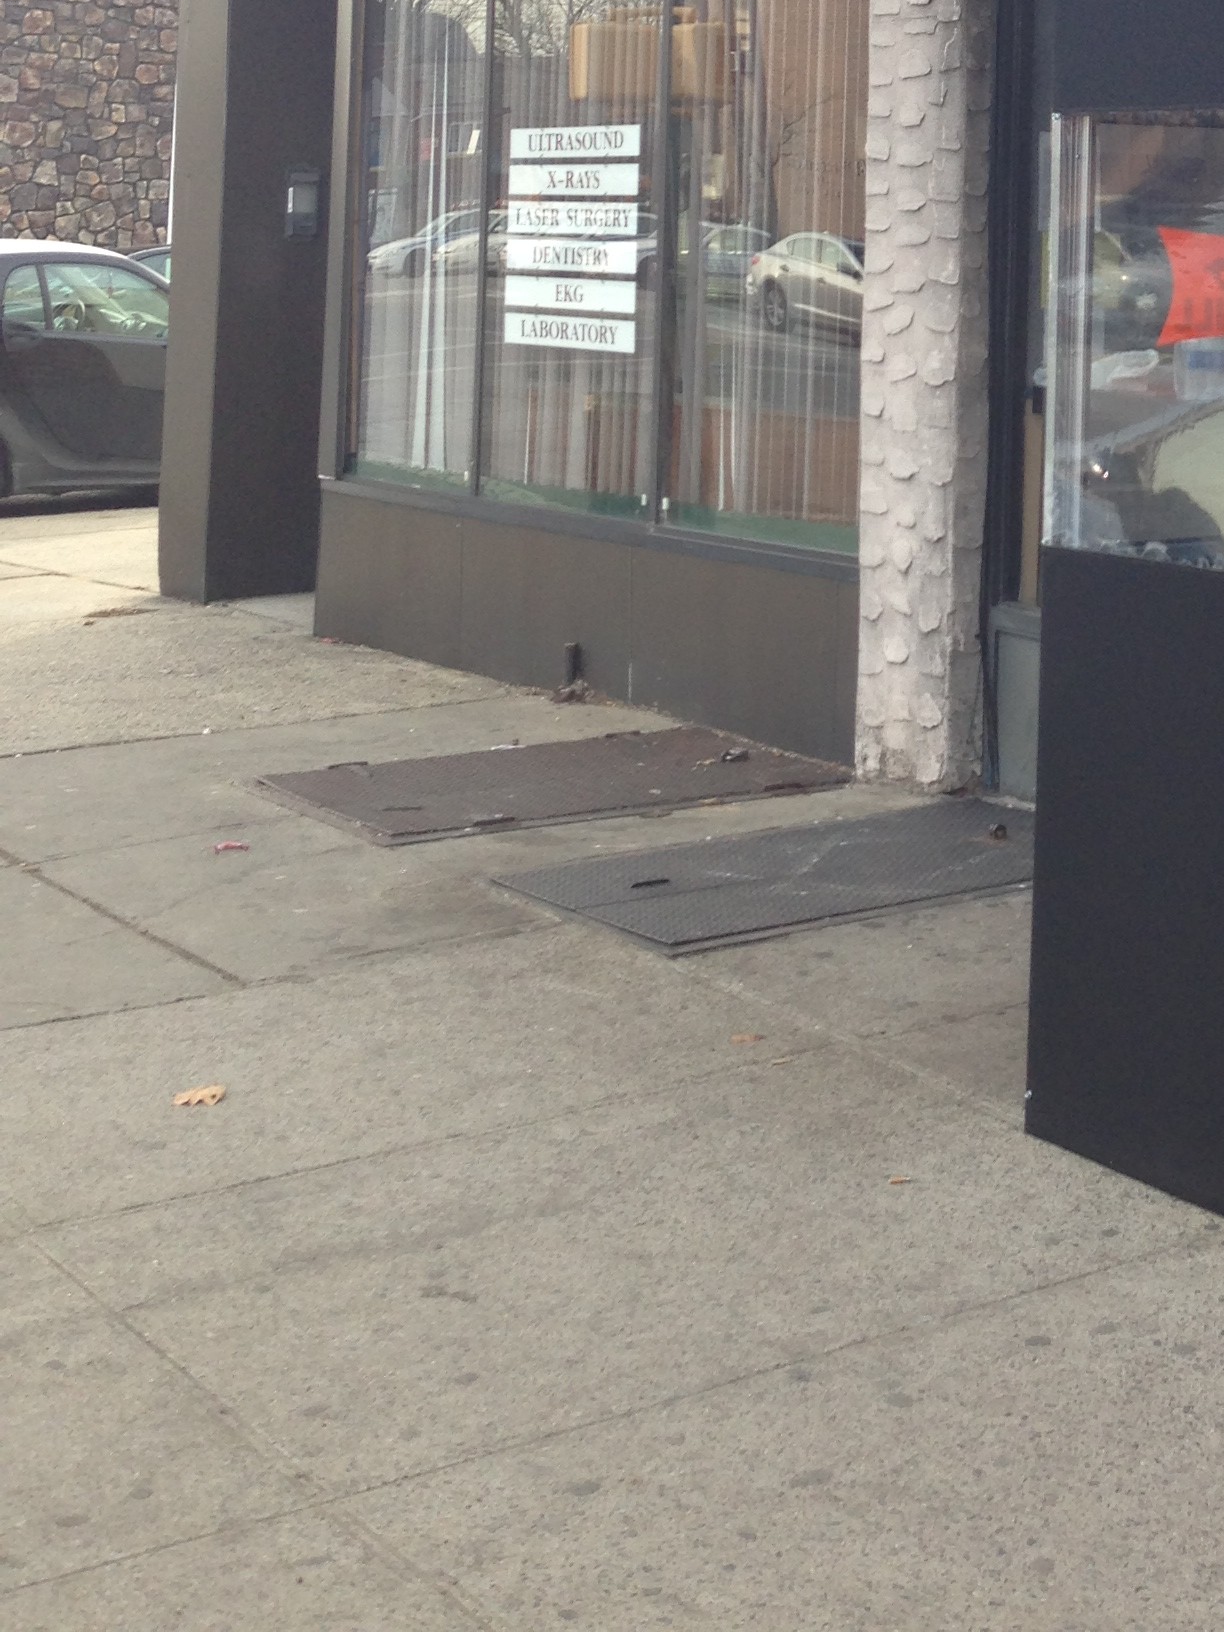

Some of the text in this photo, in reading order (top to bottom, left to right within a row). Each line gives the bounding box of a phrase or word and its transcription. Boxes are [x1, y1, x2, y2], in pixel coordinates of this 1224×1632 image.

[528, 130, 624, 152] ULTRASOUND
[547, 170, 600, 189] X-RAYS
[515, 208, 632, 228] LASER SURGERY
[532, 246, 609, 265] DENTISTRY
[554, 284, 584, 303] EKG
[520, 319, 618, 345] LABORATORY
